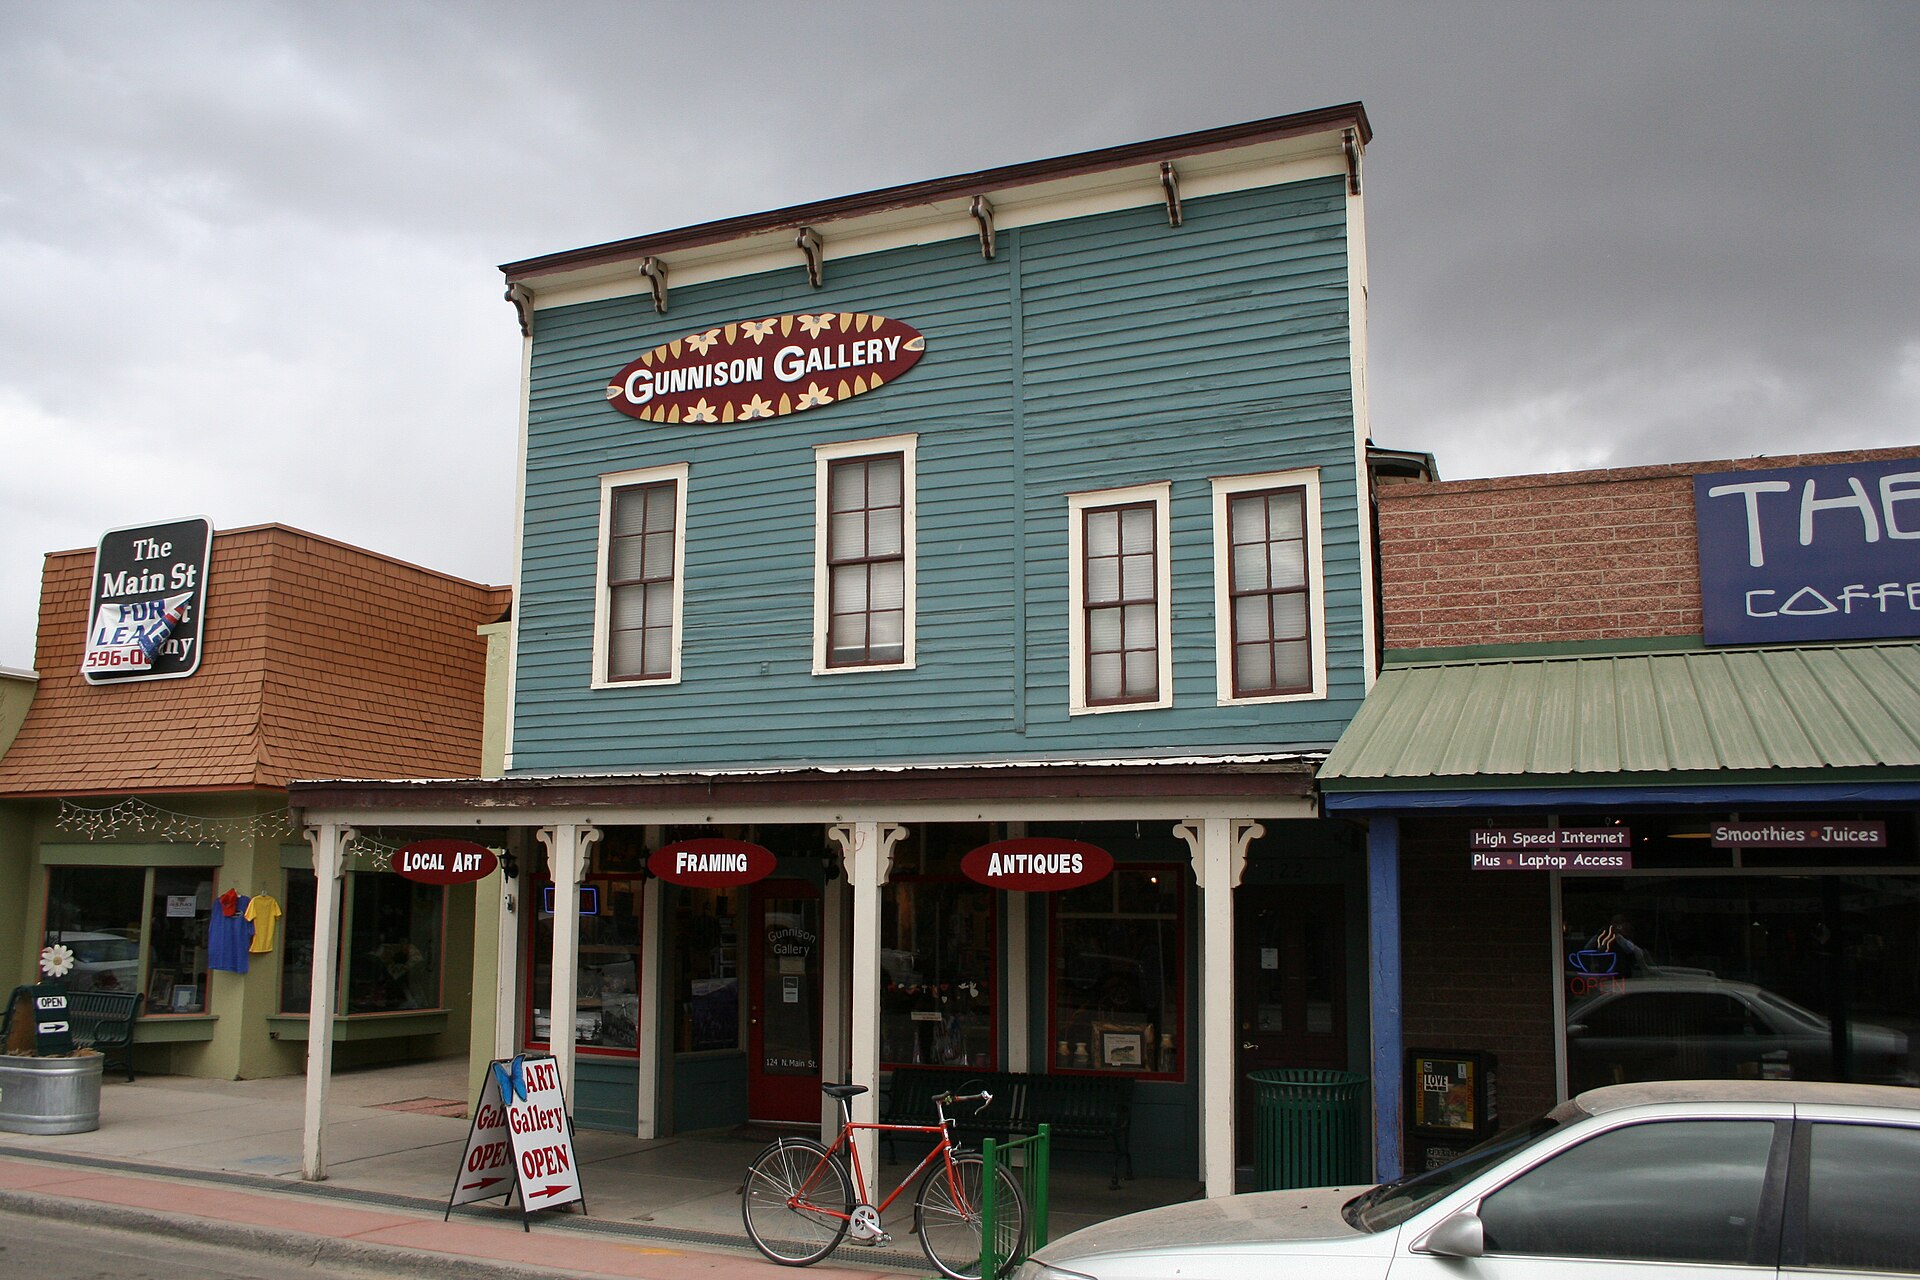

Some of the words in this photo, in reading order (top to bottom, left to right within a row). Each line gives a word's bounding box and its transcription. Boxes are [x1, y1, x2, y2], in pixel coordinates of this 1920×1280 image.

[624, 356, 764, 405] GUNNISON
[773, 335, 902, 383] GALLERY
[1709, 471, 1920, 567] THE
[133, 537, 172, 562] The
[101, 569, 165, 598] Main
[171, 563, 196, 590] St
[96, 625, 146, 646] LEA
[1475, 832, 1507, 848] High
[1512, 831, 1556, 847] Speed
[1561, 831, 1625, 844] Internet
[1715, 826, 1805, 842] Smoothies
[1821, 826, 1879, 842] Juices
[403, 851, 445, 872] LOCAL
[452, 852, 482, 873] ART
[676, 852, 748, 875] FRAMING
[987, 852, 1083, 877] ANTIQUES
[1473, 854, 1501, 866] Plus
[1519, 853, 1567, 869] Laptop
[1573, 853, 1623, 866] Access
[768, 928, 816, 944] Gunnison
[774, 943, 810, 957] Gallery
[1570, 975, 1626, 996] OPEN
[41, 997, 63, 1008] OPEN
[766, 1058, 778, 1067] 124
[807, 1060, 818, 1069] St.
[525, 1063, 556, 1094] ART
[1426, 1074, 1446, 1086] LOVE
[510, 1104, 562, 1134] Gallery
[521, 1144, 570, 1180] OPEN
